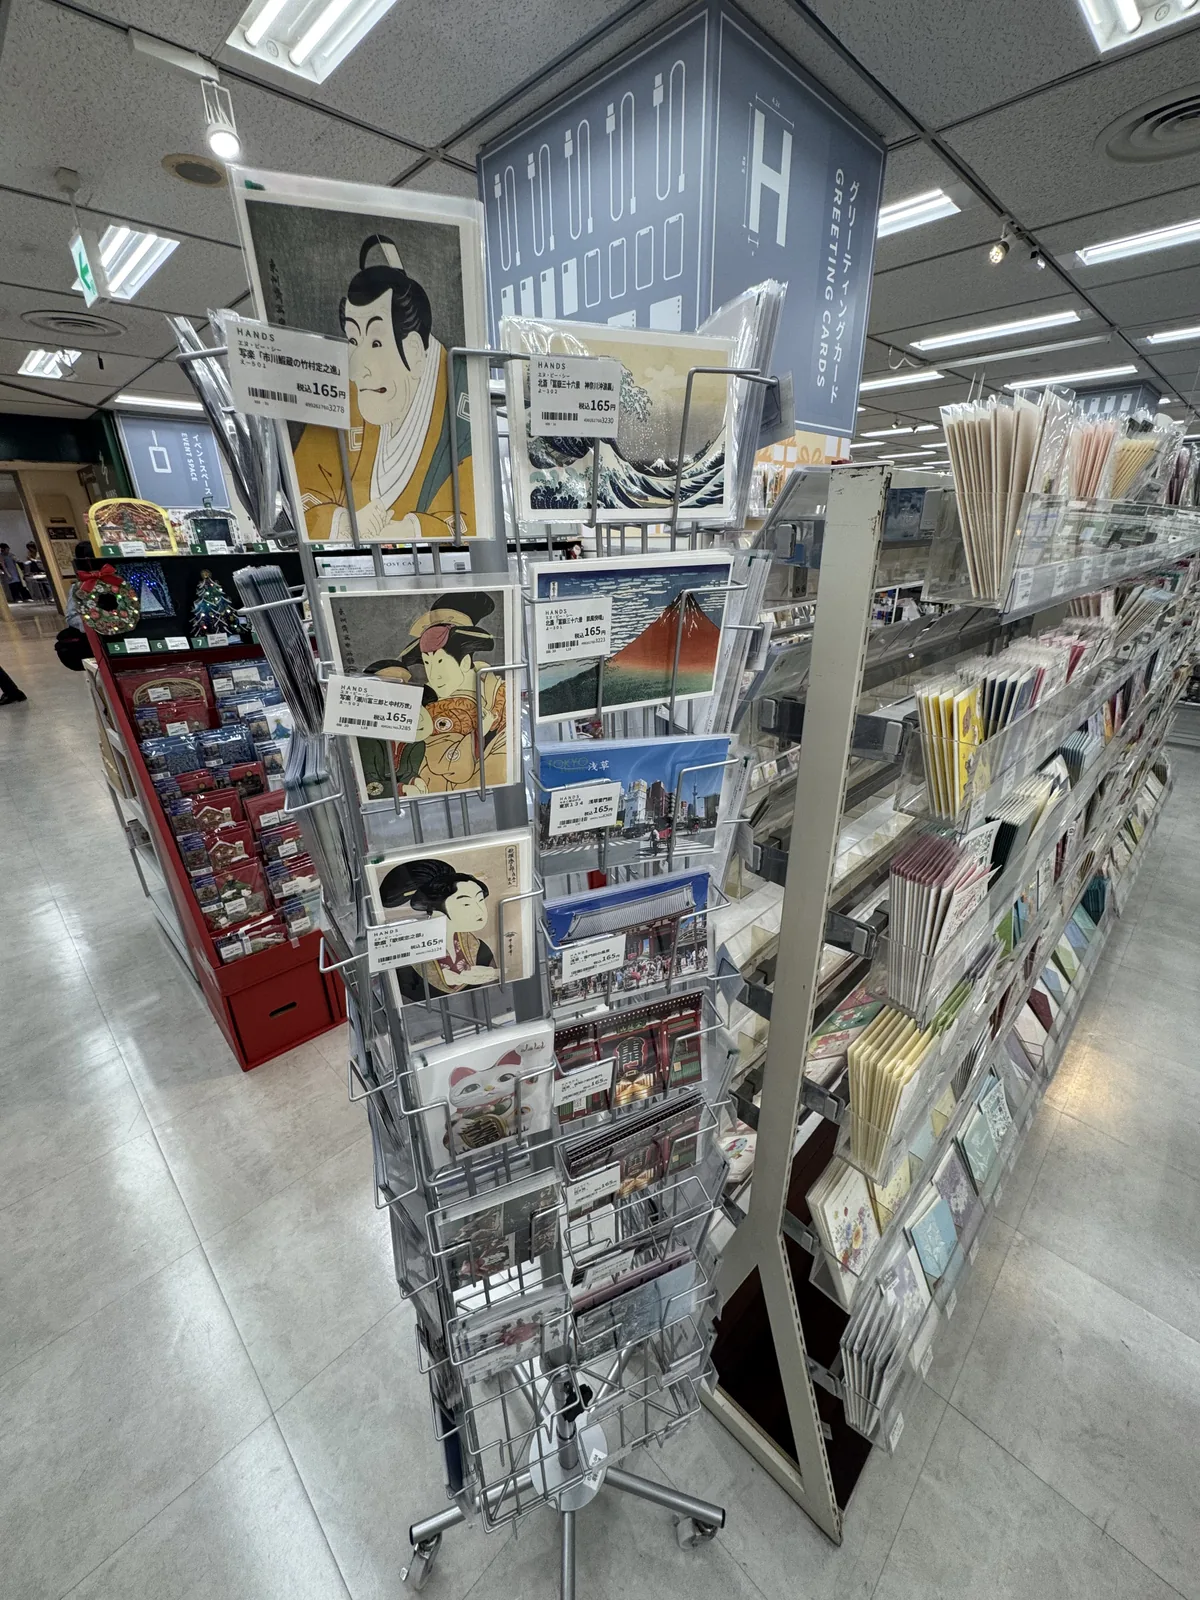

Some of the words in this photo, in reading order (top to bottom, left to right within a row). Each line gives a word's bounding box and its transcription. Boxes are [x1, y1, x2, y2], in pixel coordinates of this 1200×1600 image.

[749, 108, 793, 248] H
[824, 168, 844, 301] GREETING
[830, 180, 860, 404] グリーティングカード
[236, 327, 276, 342] HANDS
[816, 310, 832, 387] CARDS
[538, 362, 566, 370] HANDS
[296, 382, 346, 400] 税込165円
[578, 400, 616, 412] 税込165円
[182, 432, 192, 457] EVENT
[188, 458, 198, 482] SPACE
[192, 434, 212, 495] イベントスペース
[574, 626, 606, 638] 税込165円
[340, 684, 368, 693] HANDS
[373, 712, 412, 724] 税込165円
[548, 757, 588, 769] TOKYO
[588, 760, 610, 772] 浅草
[374, 928, 398, 937] HANDS
